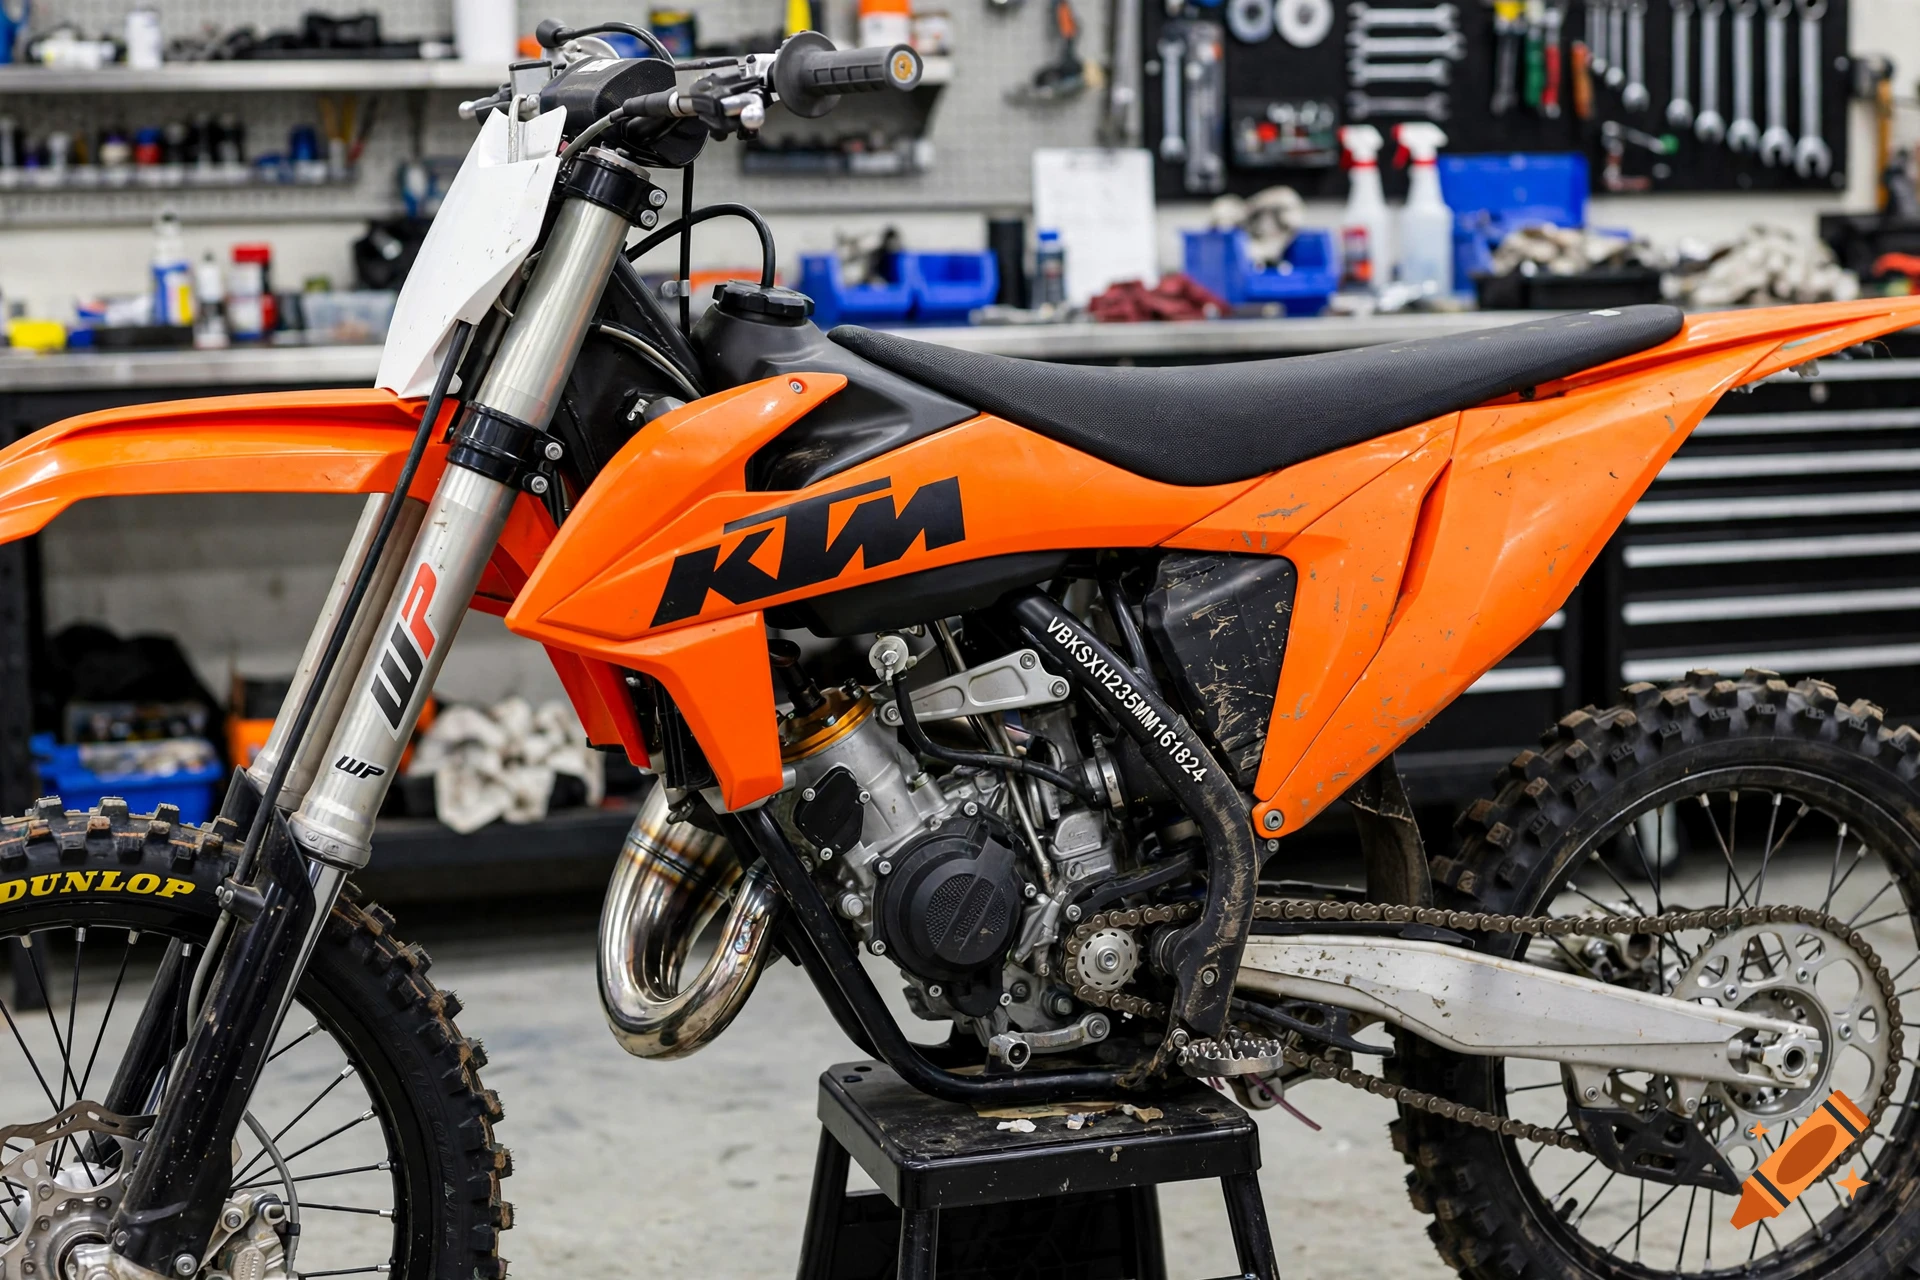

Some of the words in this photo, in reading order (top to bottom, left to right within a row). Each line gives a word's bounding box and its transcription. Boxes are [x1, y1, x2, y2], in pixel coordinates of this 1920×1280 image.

[649, 475, 967, 629] KTM
[370, 562, 437, 731] WP
[1046, 616, 1208, 783] VBKSXH235MM161824
[334, 754, 386, 780] WP
[0, 870, 196, 904] DUNLOP
